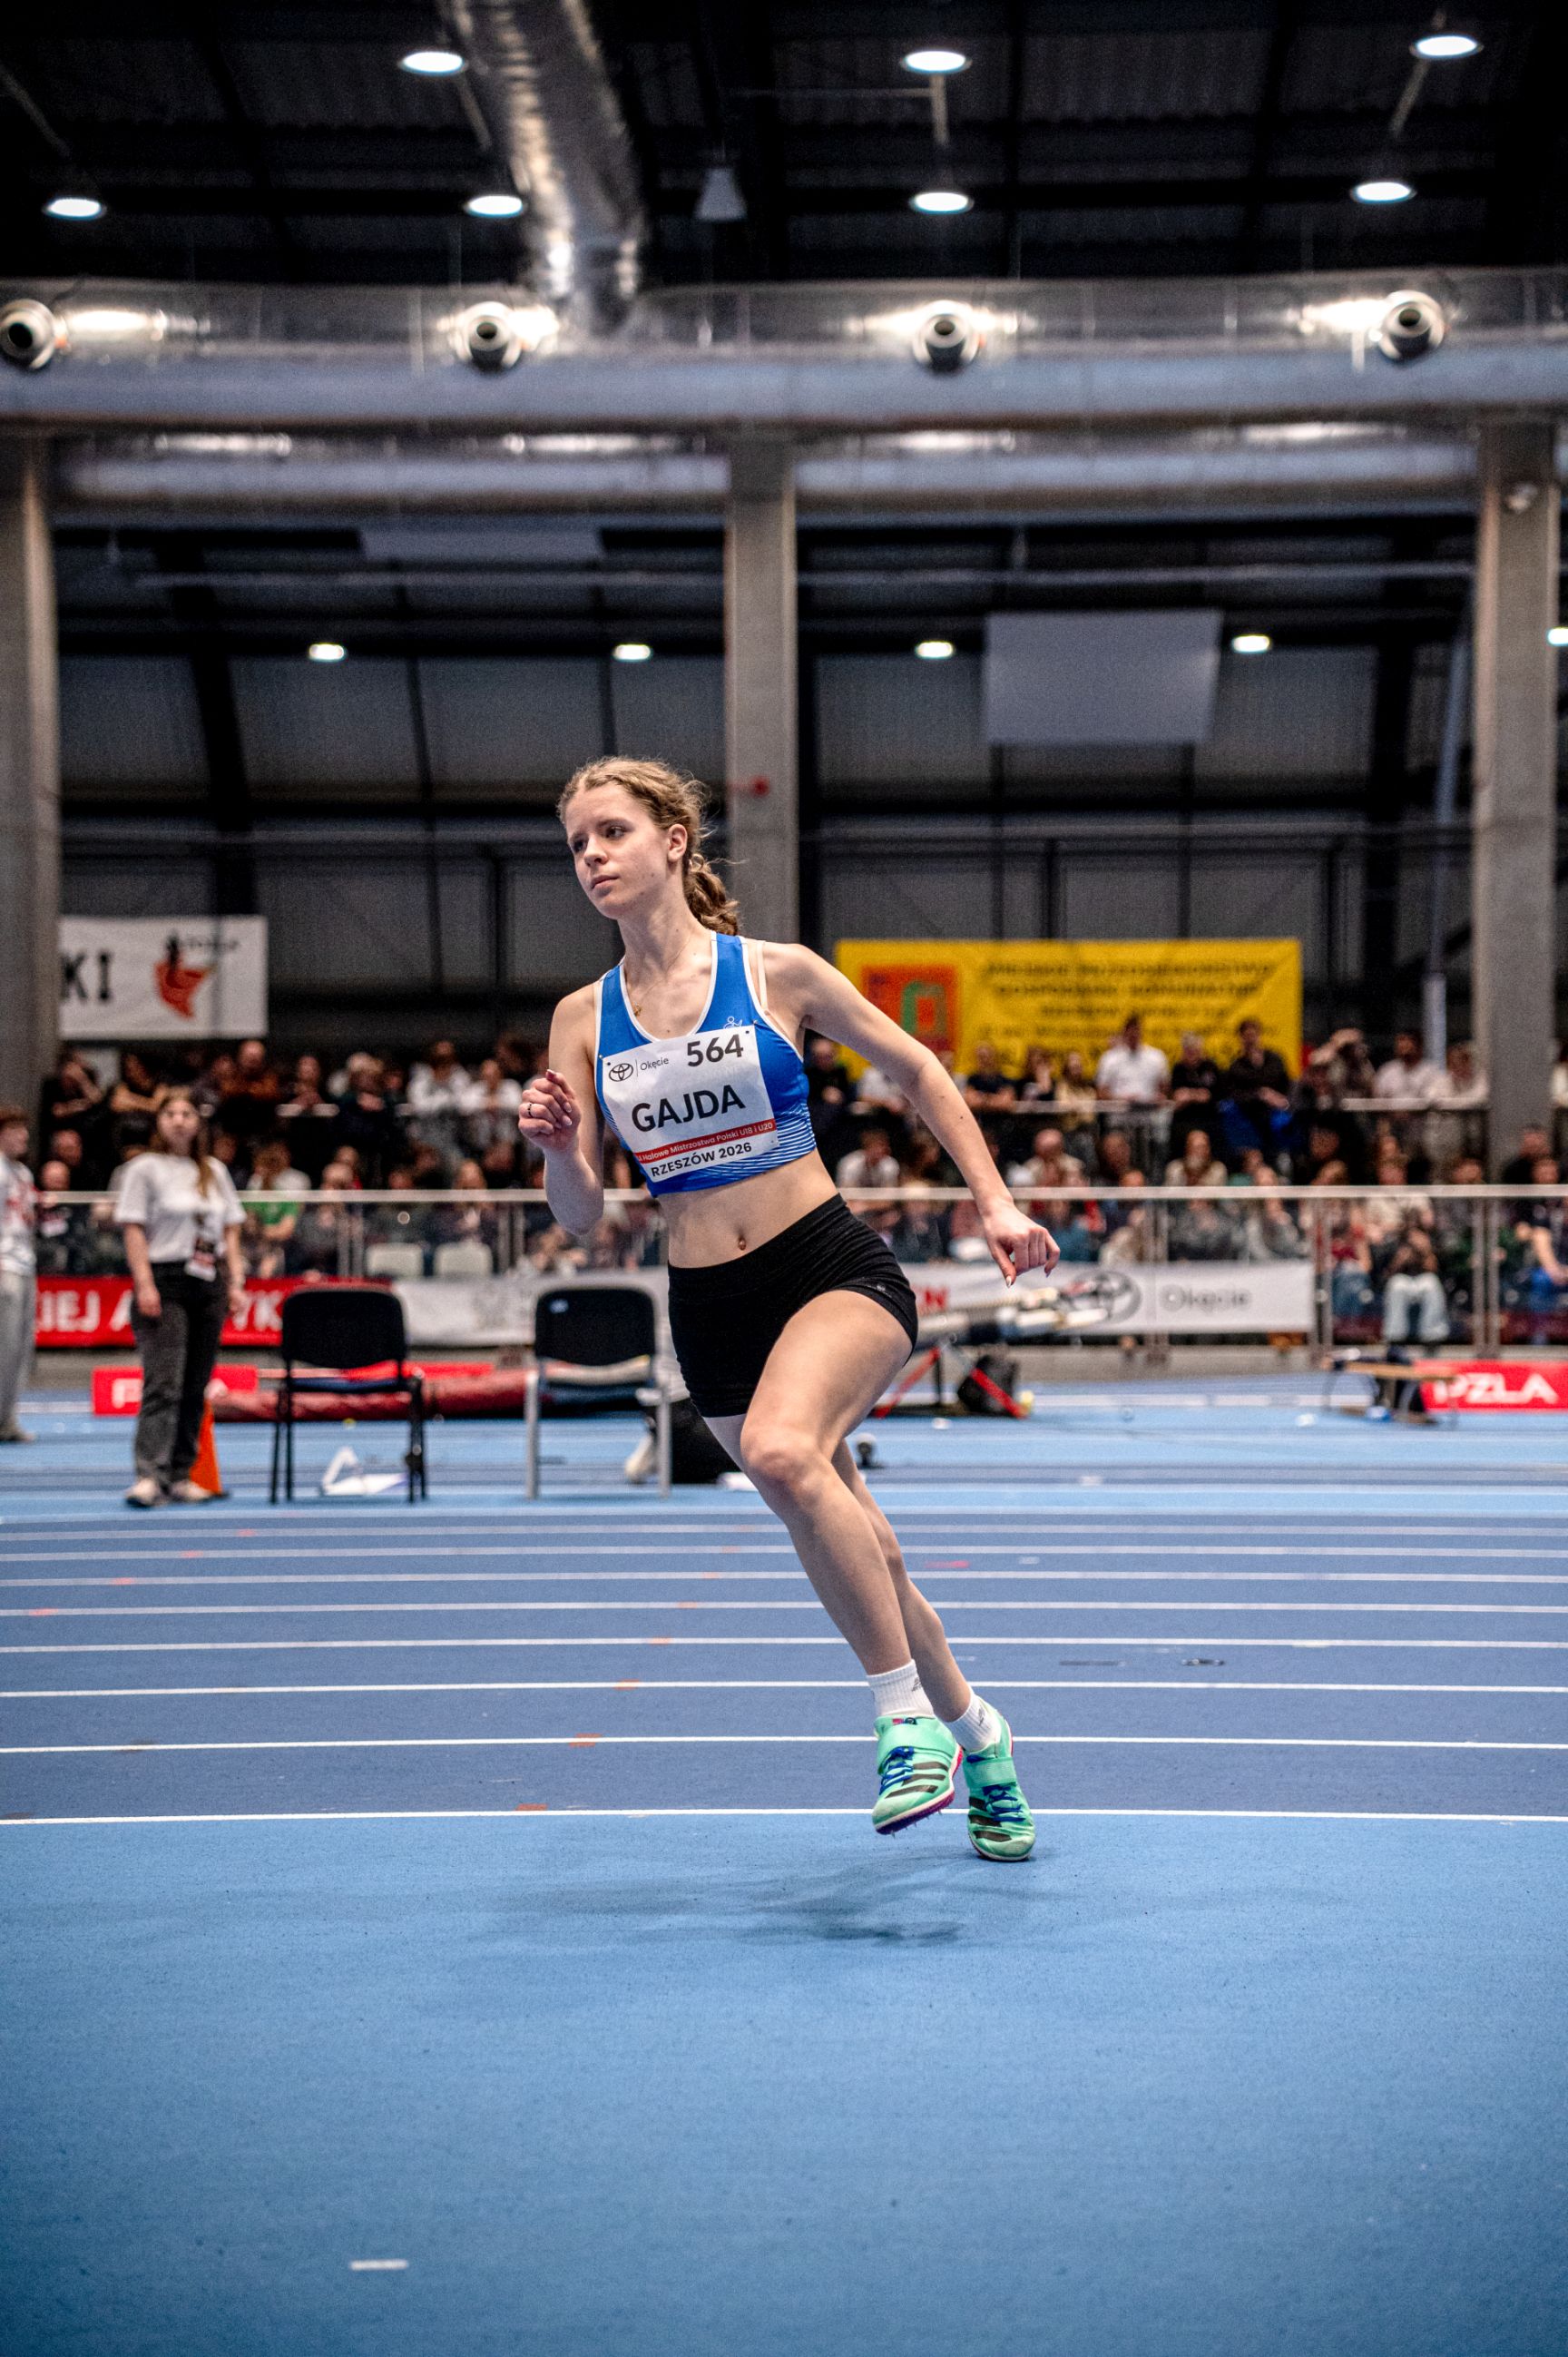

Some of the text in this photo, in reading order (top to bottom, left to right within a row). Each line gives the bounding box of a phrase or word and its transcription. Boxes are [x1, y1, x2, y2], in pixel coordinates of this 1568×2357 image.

[640, 1056, 670, 1072] Okęcie
[686, 1034, 744, 1067] 564
[632, 1085, 746, 1133] GAJDA
[642, 1148, 670, 1161] Halowe
[670, 1136, 716, 1154] Mistrzostwa
[716, 1130, 739, 1142] Polski
[740, 1126, 753, 1135] U18
[758, 1122, 773, 1132] U20
[651, 1142, 752, 1177] RZESZÓW 2026
[37, 1290, 101, 1332] IEJ
[1434, 1371, 1559, 1405] PZLA
